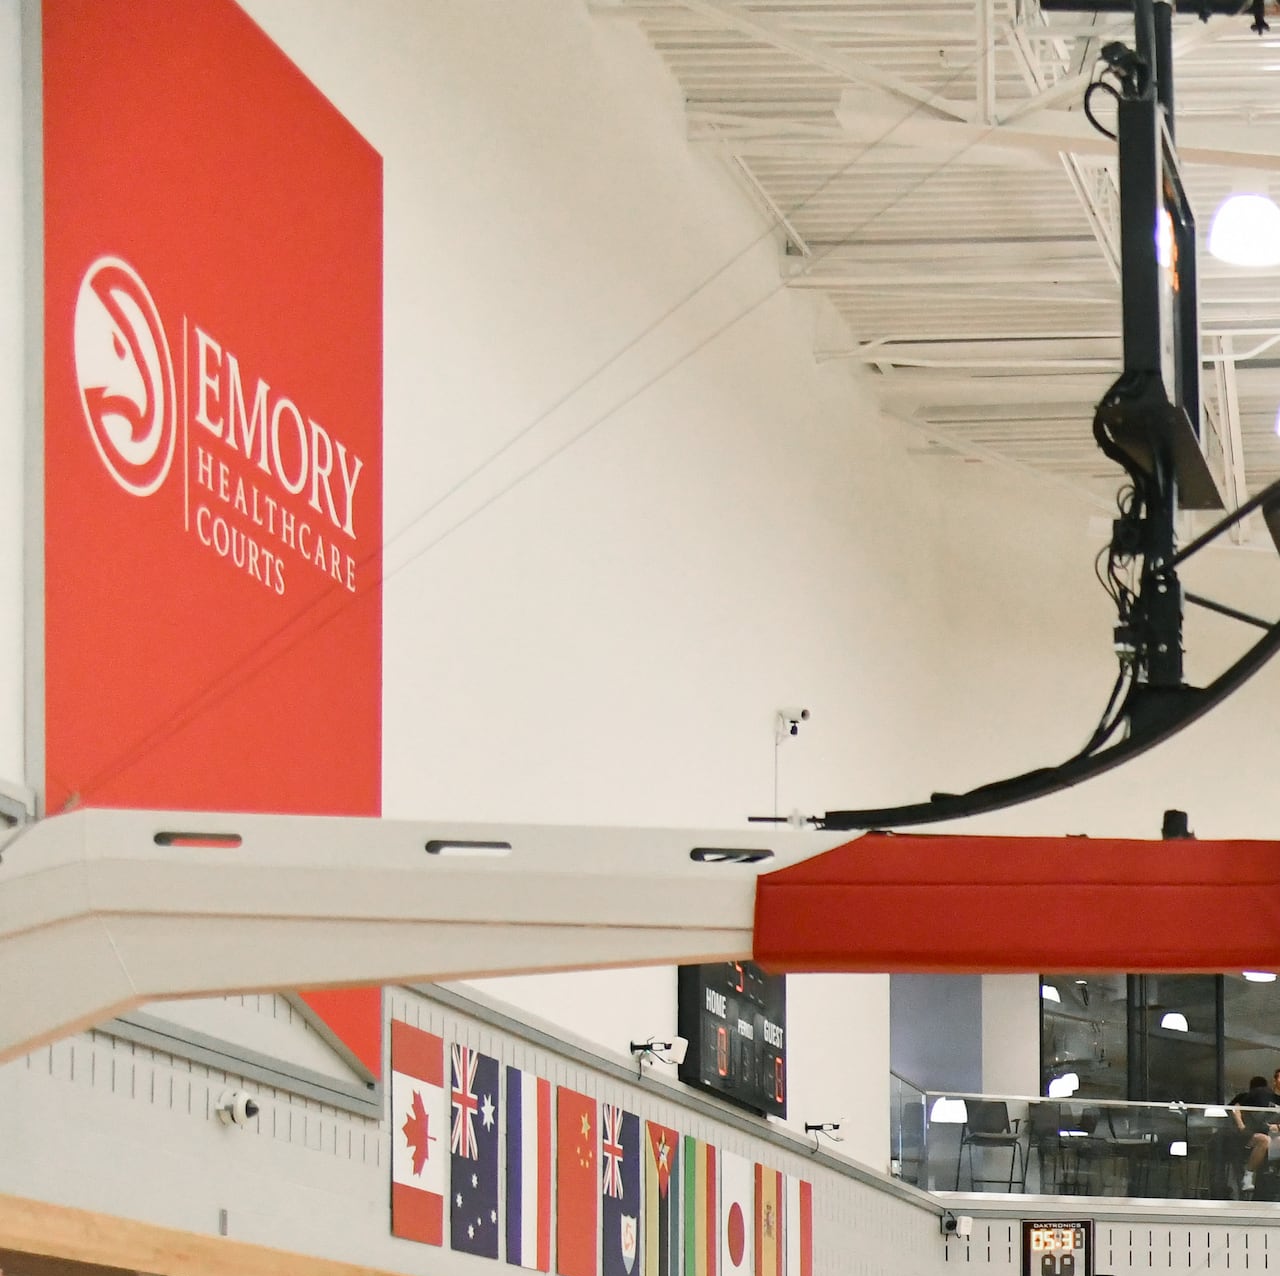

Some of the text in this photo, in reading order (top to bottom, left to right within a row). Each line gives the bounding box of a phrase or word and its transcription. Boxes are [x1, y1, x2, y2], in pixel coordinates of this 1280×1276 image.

[195, 326, 364, 541] EMORY
[196, 506, 286, 596] COURTS
[197, 446, 357, 593] HEALTHCARE
[705, 987, 784, 1049] HOME GUEST
